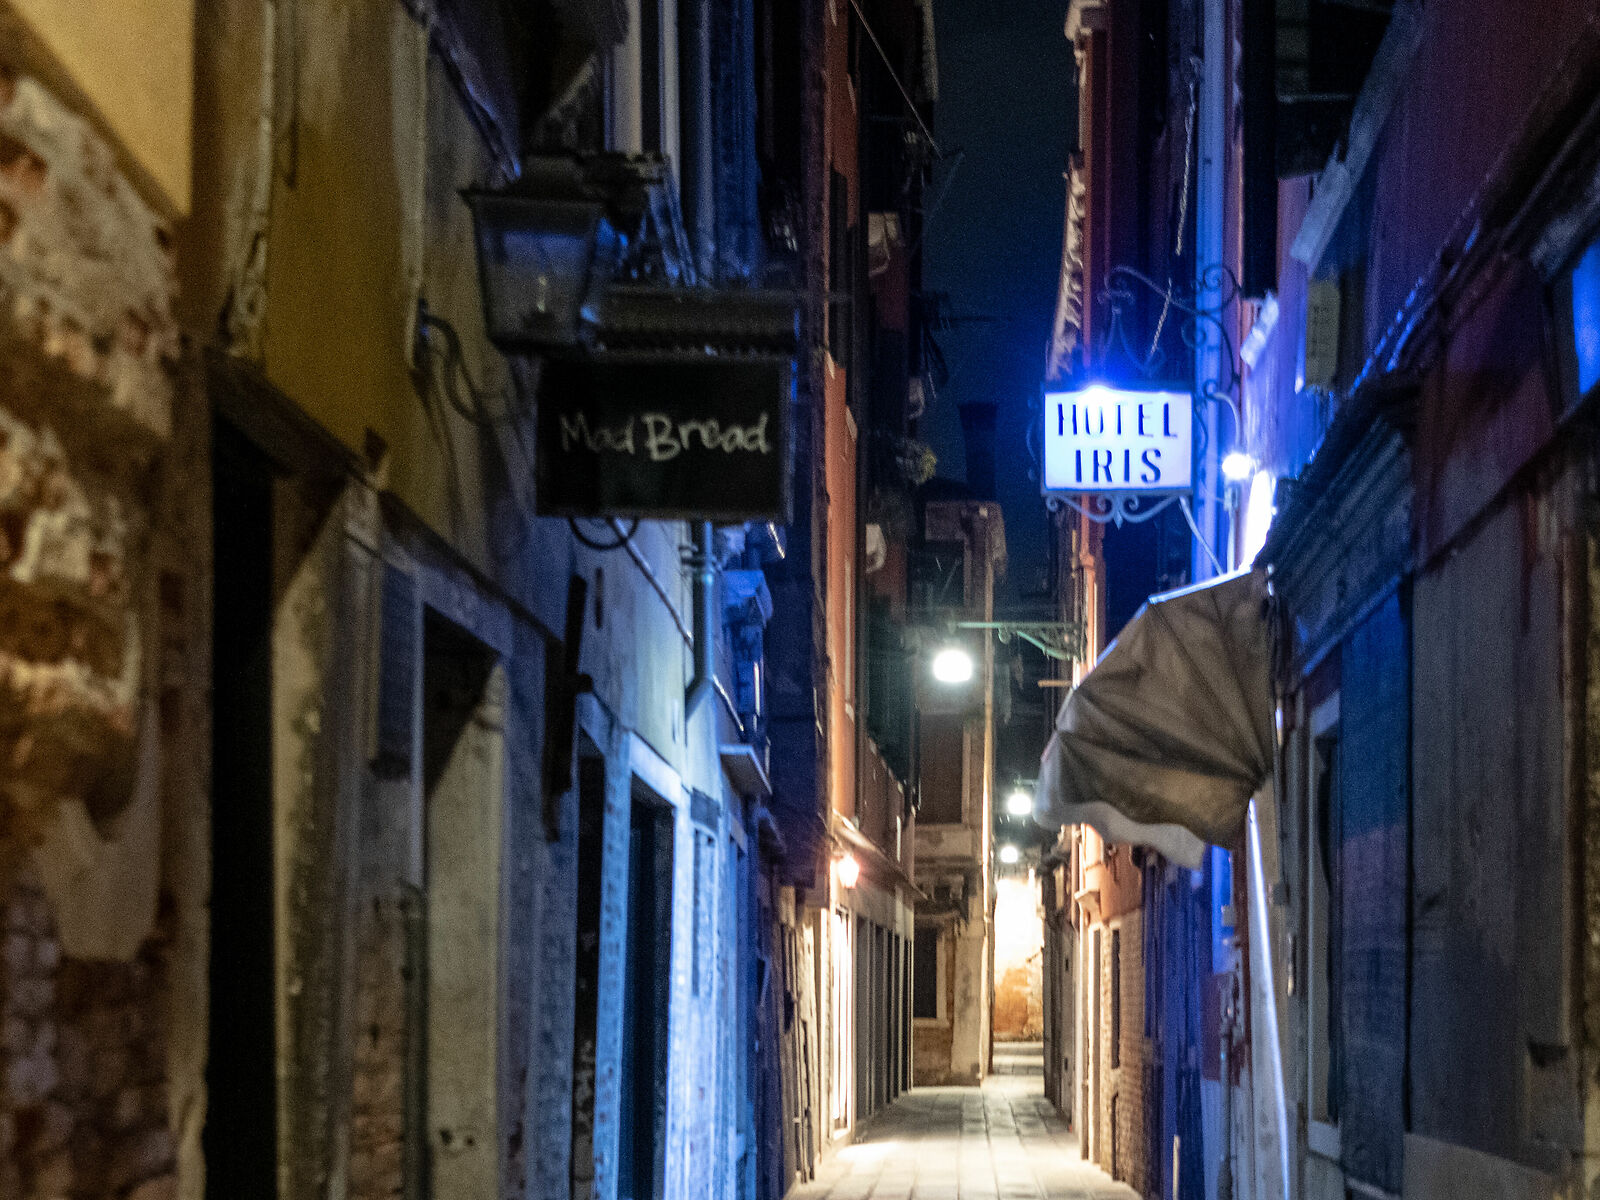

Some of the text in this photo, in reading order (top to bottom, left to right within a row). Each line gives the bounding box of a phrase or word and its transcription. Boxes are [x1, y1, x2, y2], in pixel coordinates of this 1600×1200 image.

[559, 410, 770, 462] Mad Bread
[1057, 402, 1178, 438] HOTEL
[1075, 448, 1162, 484] IRIS
